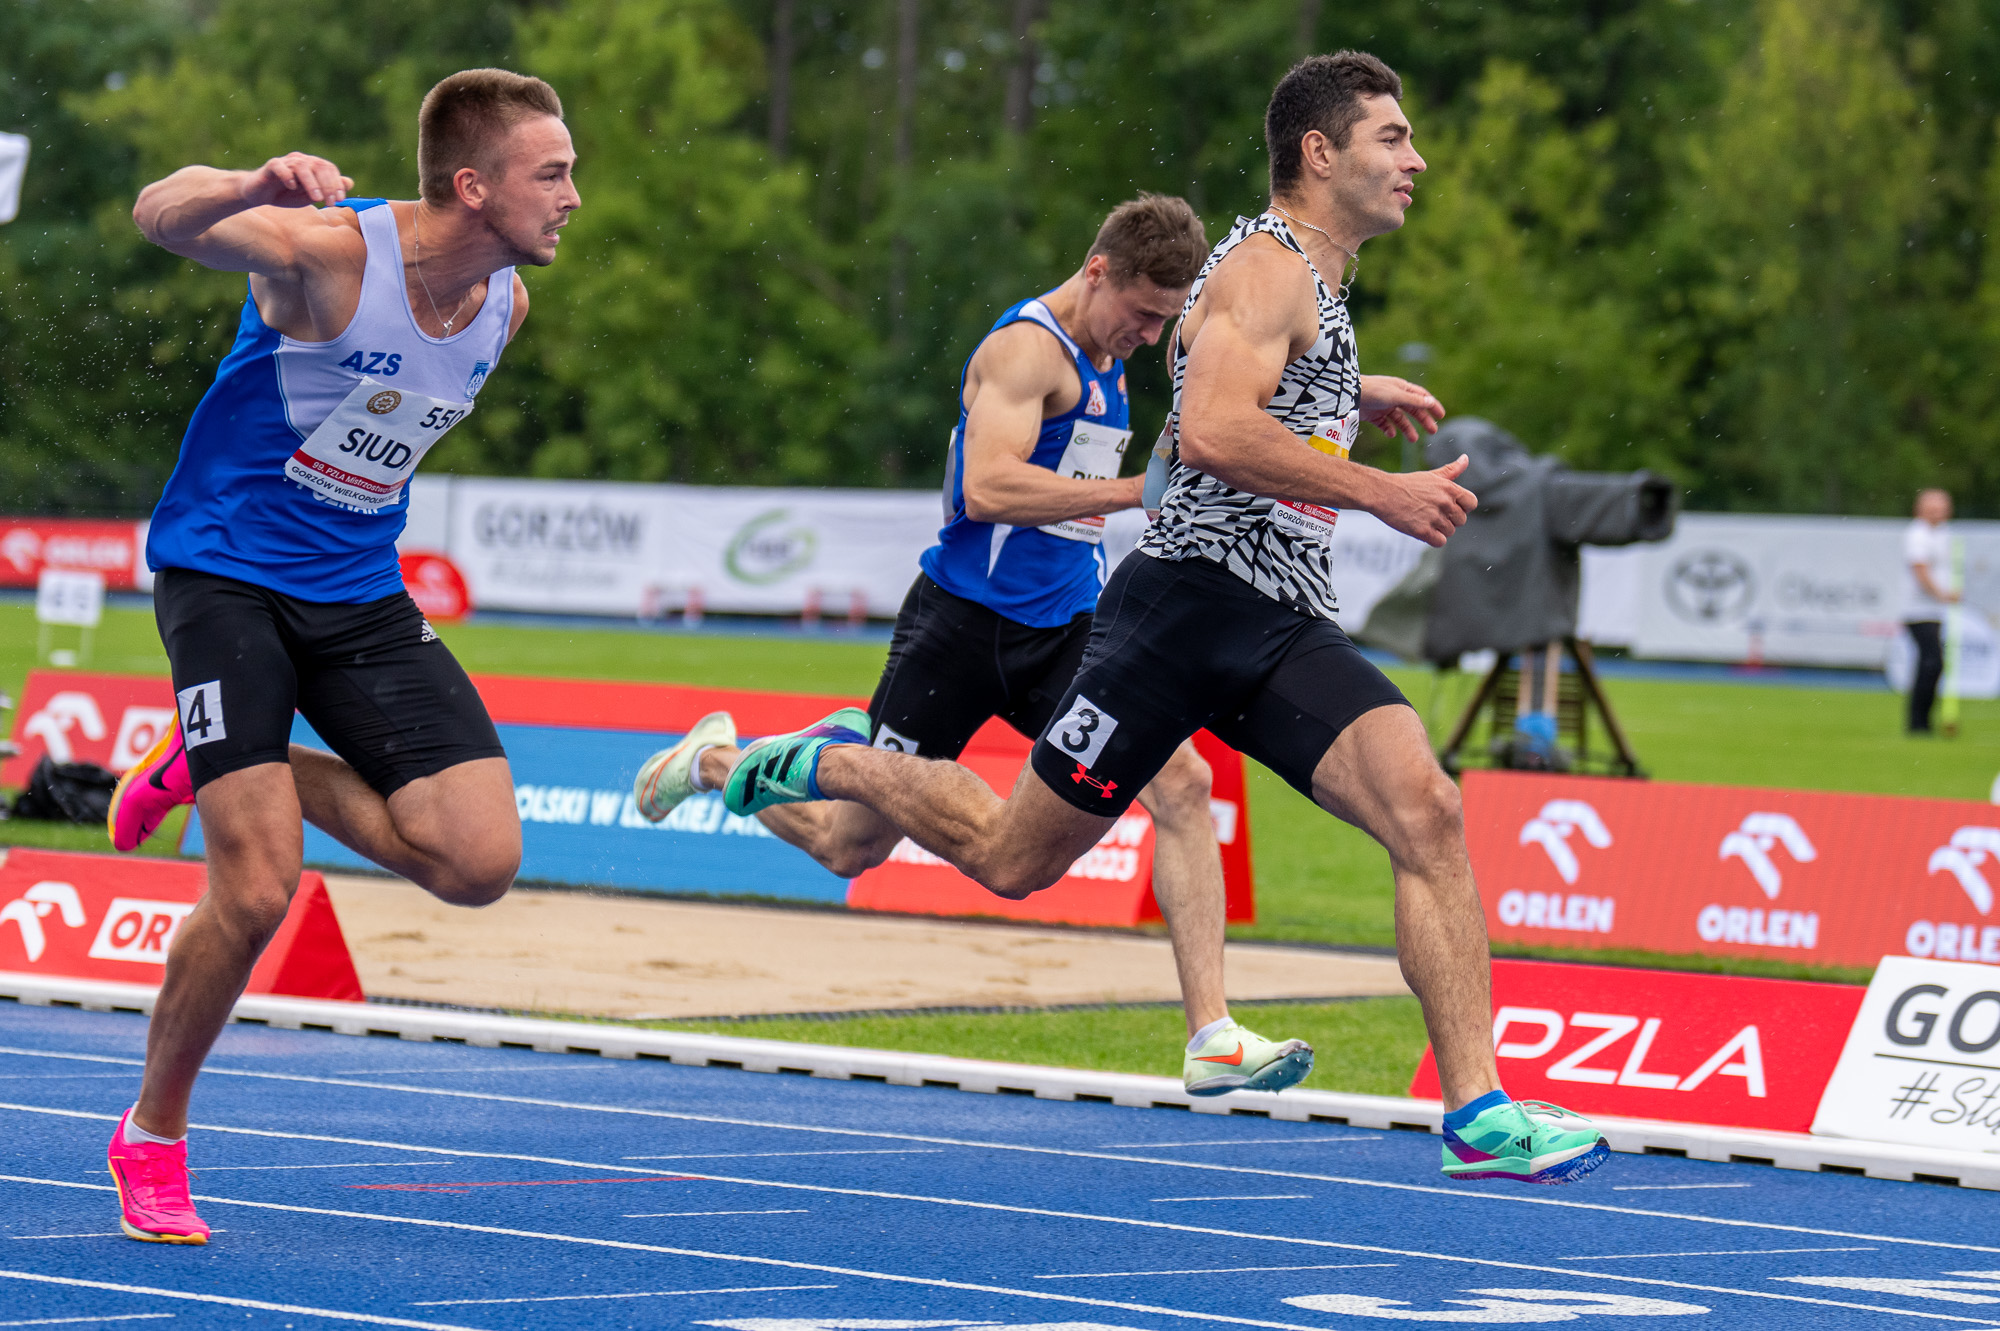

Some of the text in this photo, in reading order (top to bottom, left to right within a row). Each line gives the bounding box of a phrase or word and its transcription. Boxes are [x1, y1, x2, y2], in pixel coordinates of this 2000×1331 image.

[338, 350, 402, 376] AZS
[338, 428, 414, 471] SIUD
[1325, 428, 1342, 442] ORL
[291, 466, 335, 490] GORZÓW
[312, 461, 325, 473] 99.
[325, 467, 346, 482] PZLA
[1277, 509, 1305, 527] GORZÓW
[186, 688, 212, 739] 4
[1061, 707, 1100, 754] 3
[514, 784, 590, 824] OLSKI
[589, 788, 623, 827] W
[1499, 889, 1614, 933] ORLEN
[1697, 904, 1818, 949] ORLEN
[1885, 983, 2000, 1054] GO
[1493, 1006, 1767, 1098] PZLA
